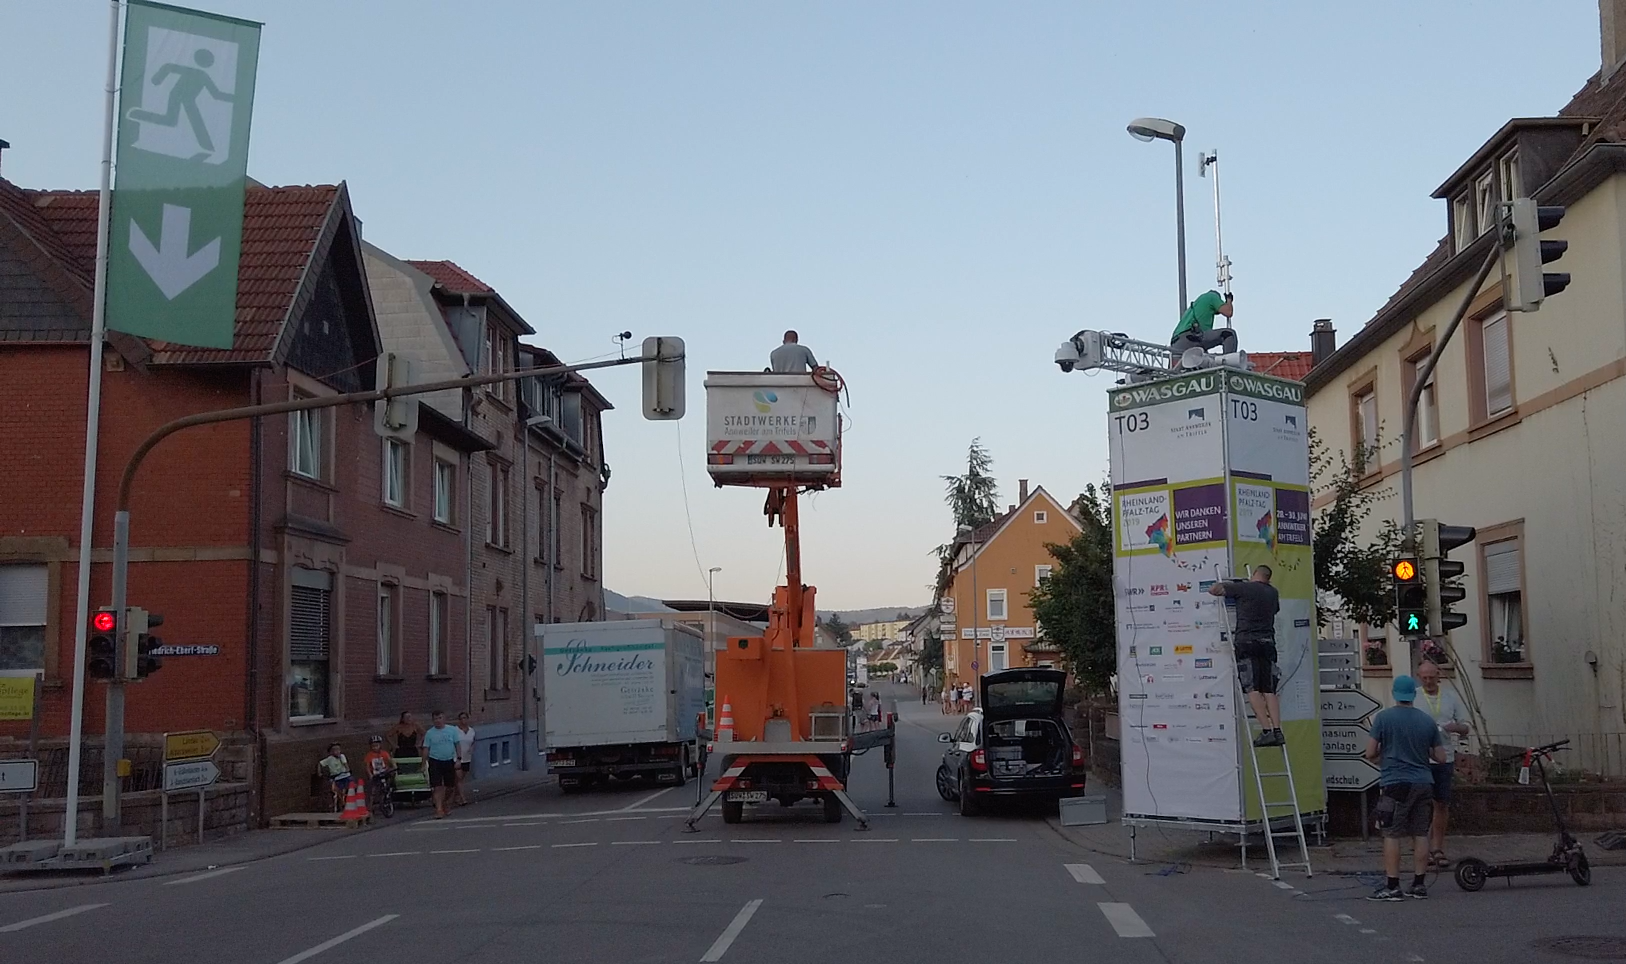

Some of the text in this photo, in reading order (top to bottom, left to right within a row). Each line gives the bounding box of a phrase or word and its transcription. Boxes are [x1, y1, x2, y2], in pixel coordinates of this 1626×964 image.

[1132, 376, 1214, 404] WASGAU
[1243, 377, 1301, 402] WASGAU
[1231, 399, 1258, 421] T03
[724, 415, 797, 426] STADTWERKE
[1114, 411, 1150, 435] T03
[724, 427, 760, 436] Annweiler
[774, 427, 796, 436] Trifels
[1238, 488, 1270, 499] RHEINLAND-
[1122, 495, 1167, 507] RHEINLAND-
[1238, 498, 1266, 508] PFALZ-TAG
[1122, 506, 1160, 517] PFALZ-TAG
[1175, 506, 1221, 519] WIR DANKEN
[1176, 519, 1209, 530] UNSEREN
[1177, 530, 1213, 542] PARTNERN
[556, 639, 654, 676] Schneider
